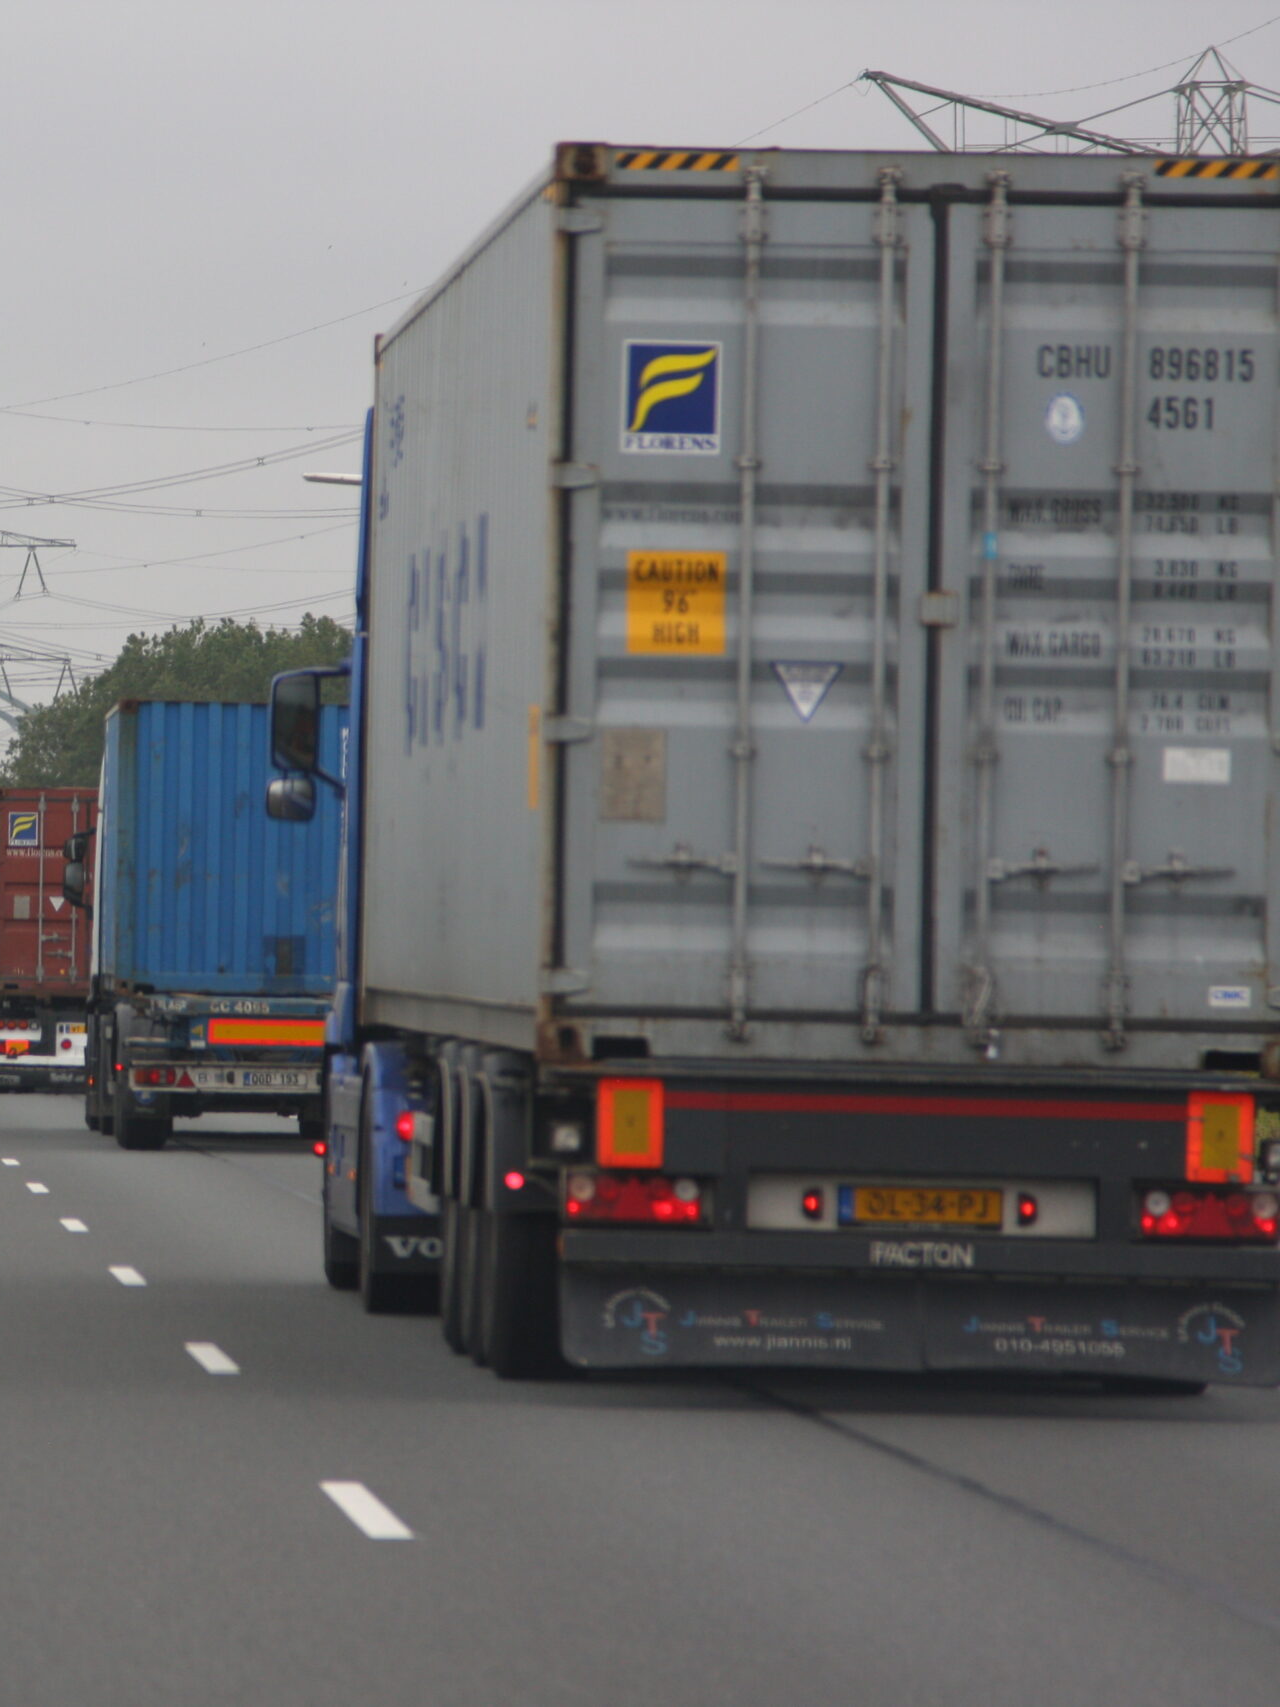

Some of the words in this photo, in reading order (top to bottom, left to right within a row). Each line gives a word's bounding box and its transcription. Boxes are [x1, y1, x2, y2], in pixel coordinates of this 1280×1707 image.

[1037, 345, 1111, 379] CBHU
[1149, 346, 1254, 382] 896815
[624, 435, 718, 450] FLORENS
[633, 559, 720, 583] CAUTION
[652, 621, 700, 645] HIGH
[870, 1241, 974, 1267] PACTON
